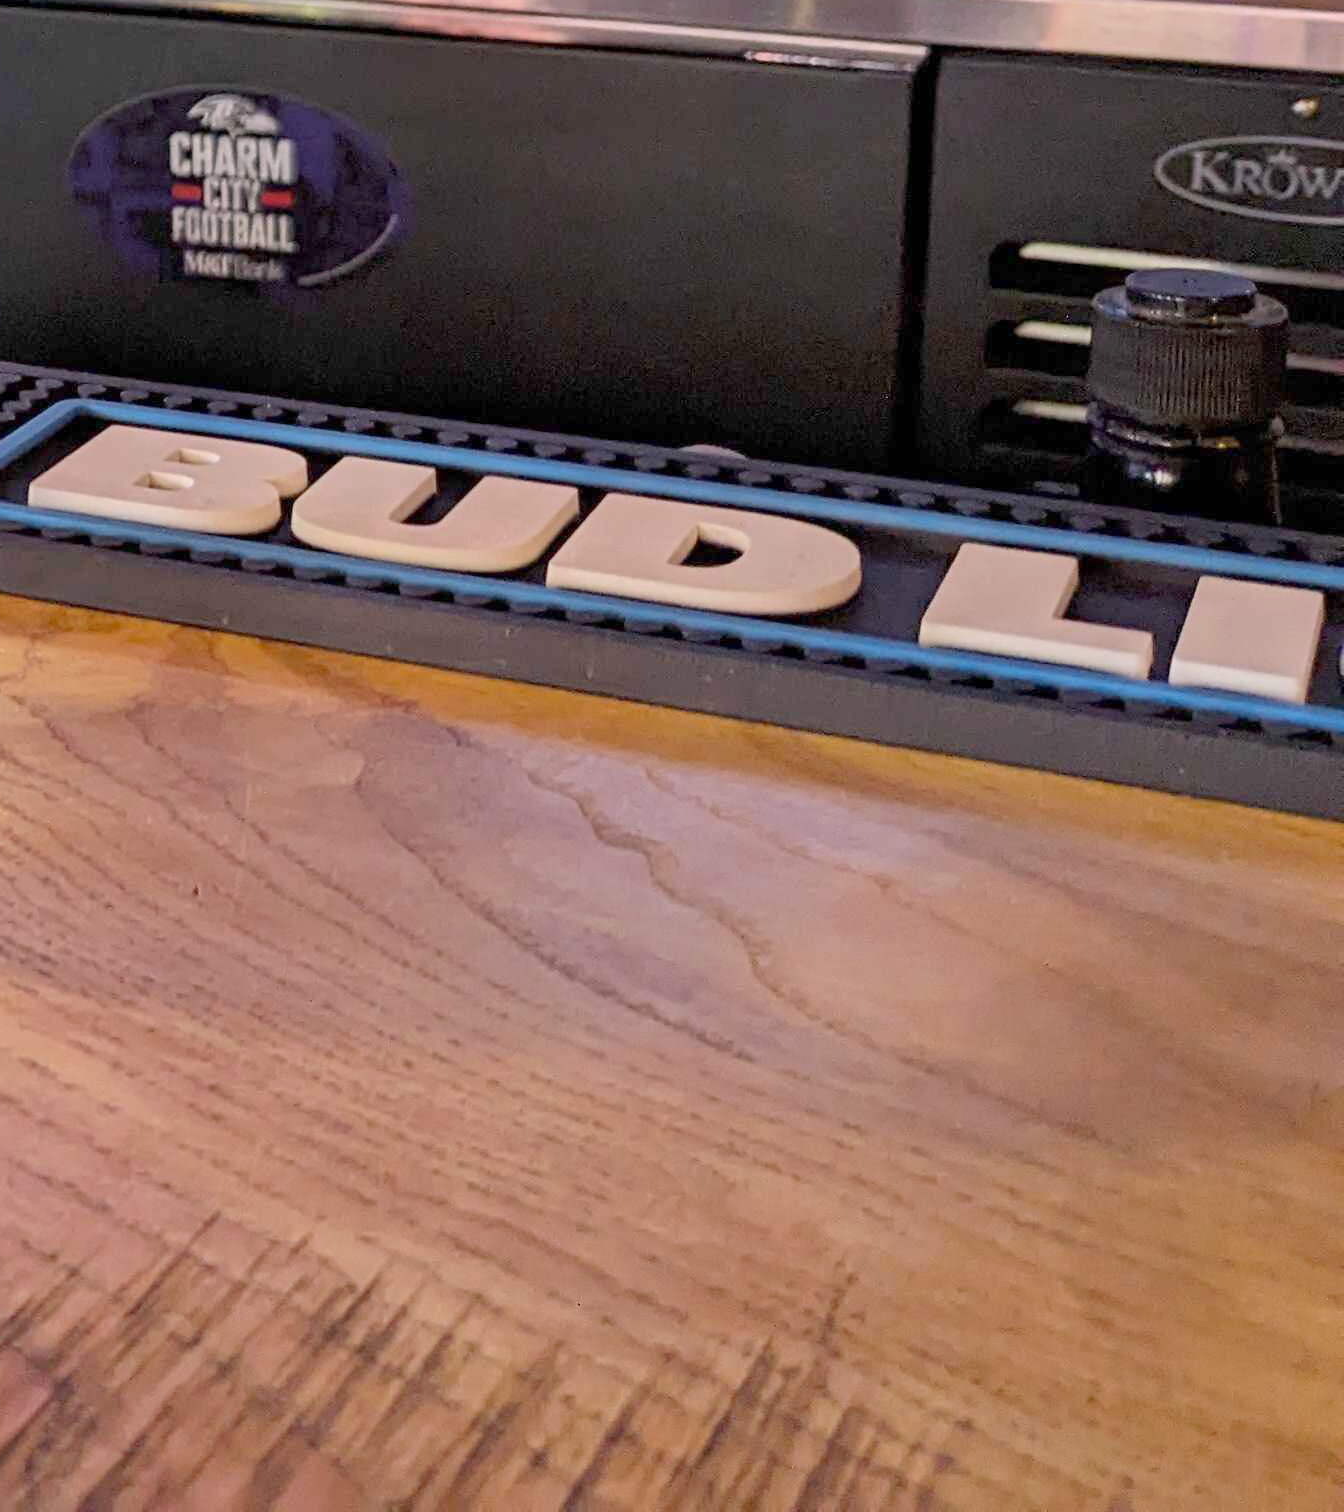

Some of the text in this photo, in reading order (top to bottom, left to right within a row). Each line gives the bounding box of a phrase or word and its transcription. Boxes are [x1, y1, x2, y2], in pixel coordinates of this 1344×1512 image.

[168, 130, 296, 185] CHARM
[1189, 149, 1344, 201] KROW
[203, 177, 261, 213] CITY
[171, 205, 299, 254] FOOTBALL
[26, 423, 1344, 705] BUD LI
